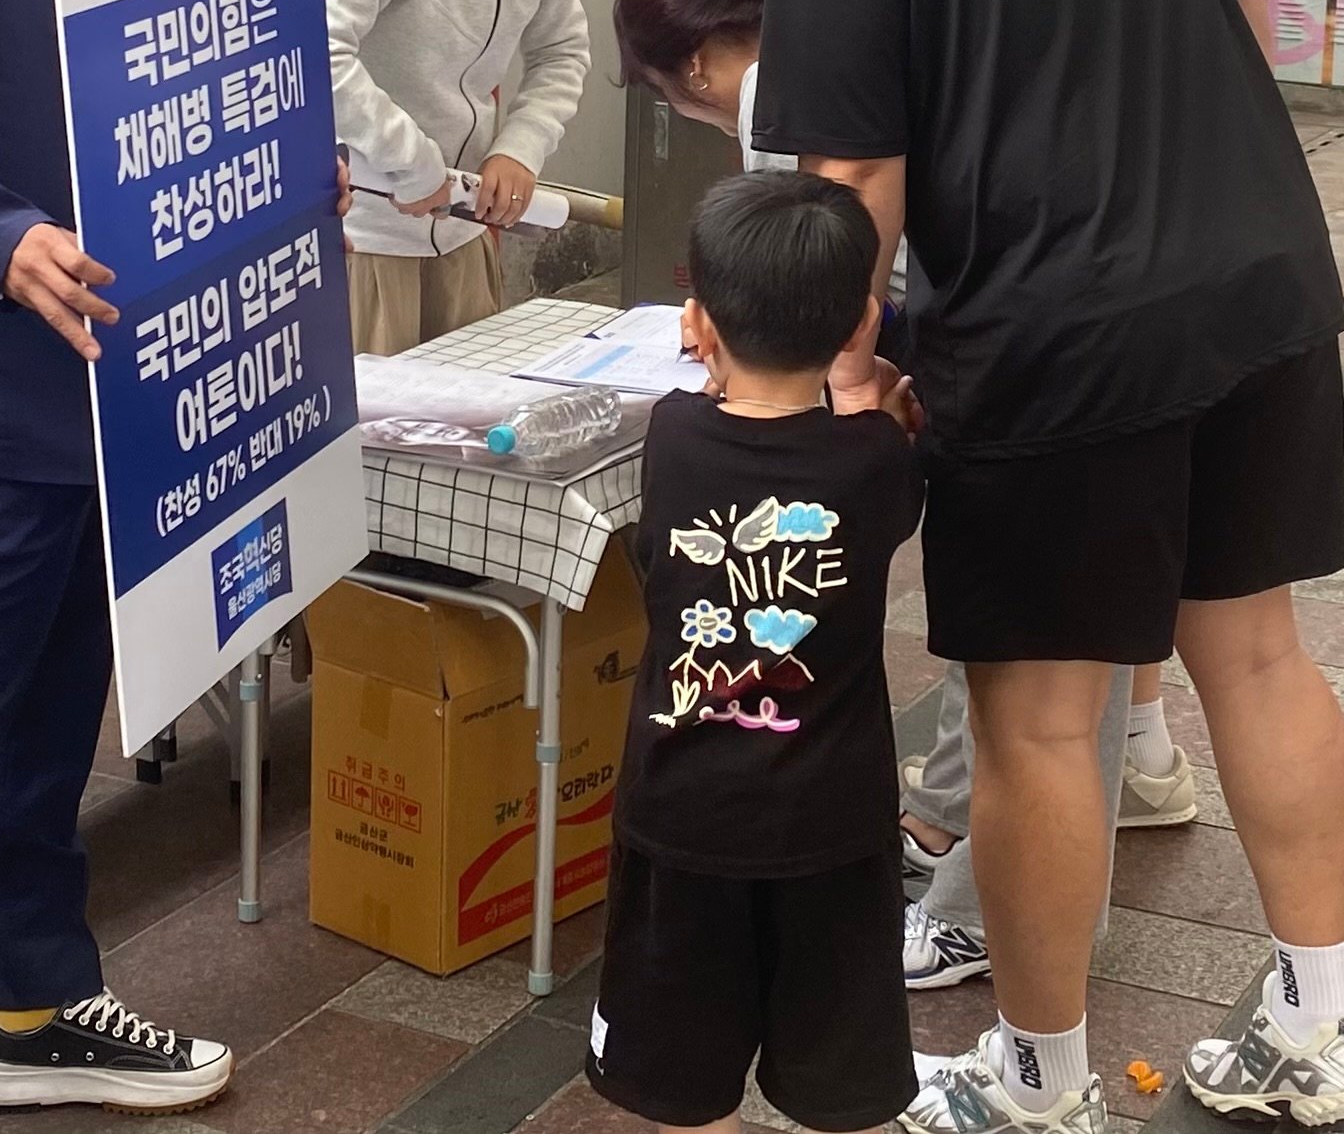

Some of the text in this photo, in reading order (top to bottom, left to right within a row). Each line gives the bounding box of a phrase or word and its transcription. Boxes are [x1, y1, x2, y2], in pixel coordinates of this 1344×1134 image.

[114, 47, 305, 186] 채해병 특검에
[150, 139, 282, 261] 찬성하라!
[136, 228, 322, 381] 국민의 압도적
[176, 320, 303, 452] 여론이다!
[156, 472, 201, 537] (찬성
[206, 444, 246, 502] 67%
[249, 417, 283, 472] 반대
[219, 523, 282, 595] 조국혁신당
[227, 560, 281, 620] 울산광역시당
[726, 546, 848, 606] NIKE
[345, 755, 405, 791] 취급주의
[1279, 949, 1300, 1007] UMBRO
[1014, 1037, 1042, 1089] UMBRO
